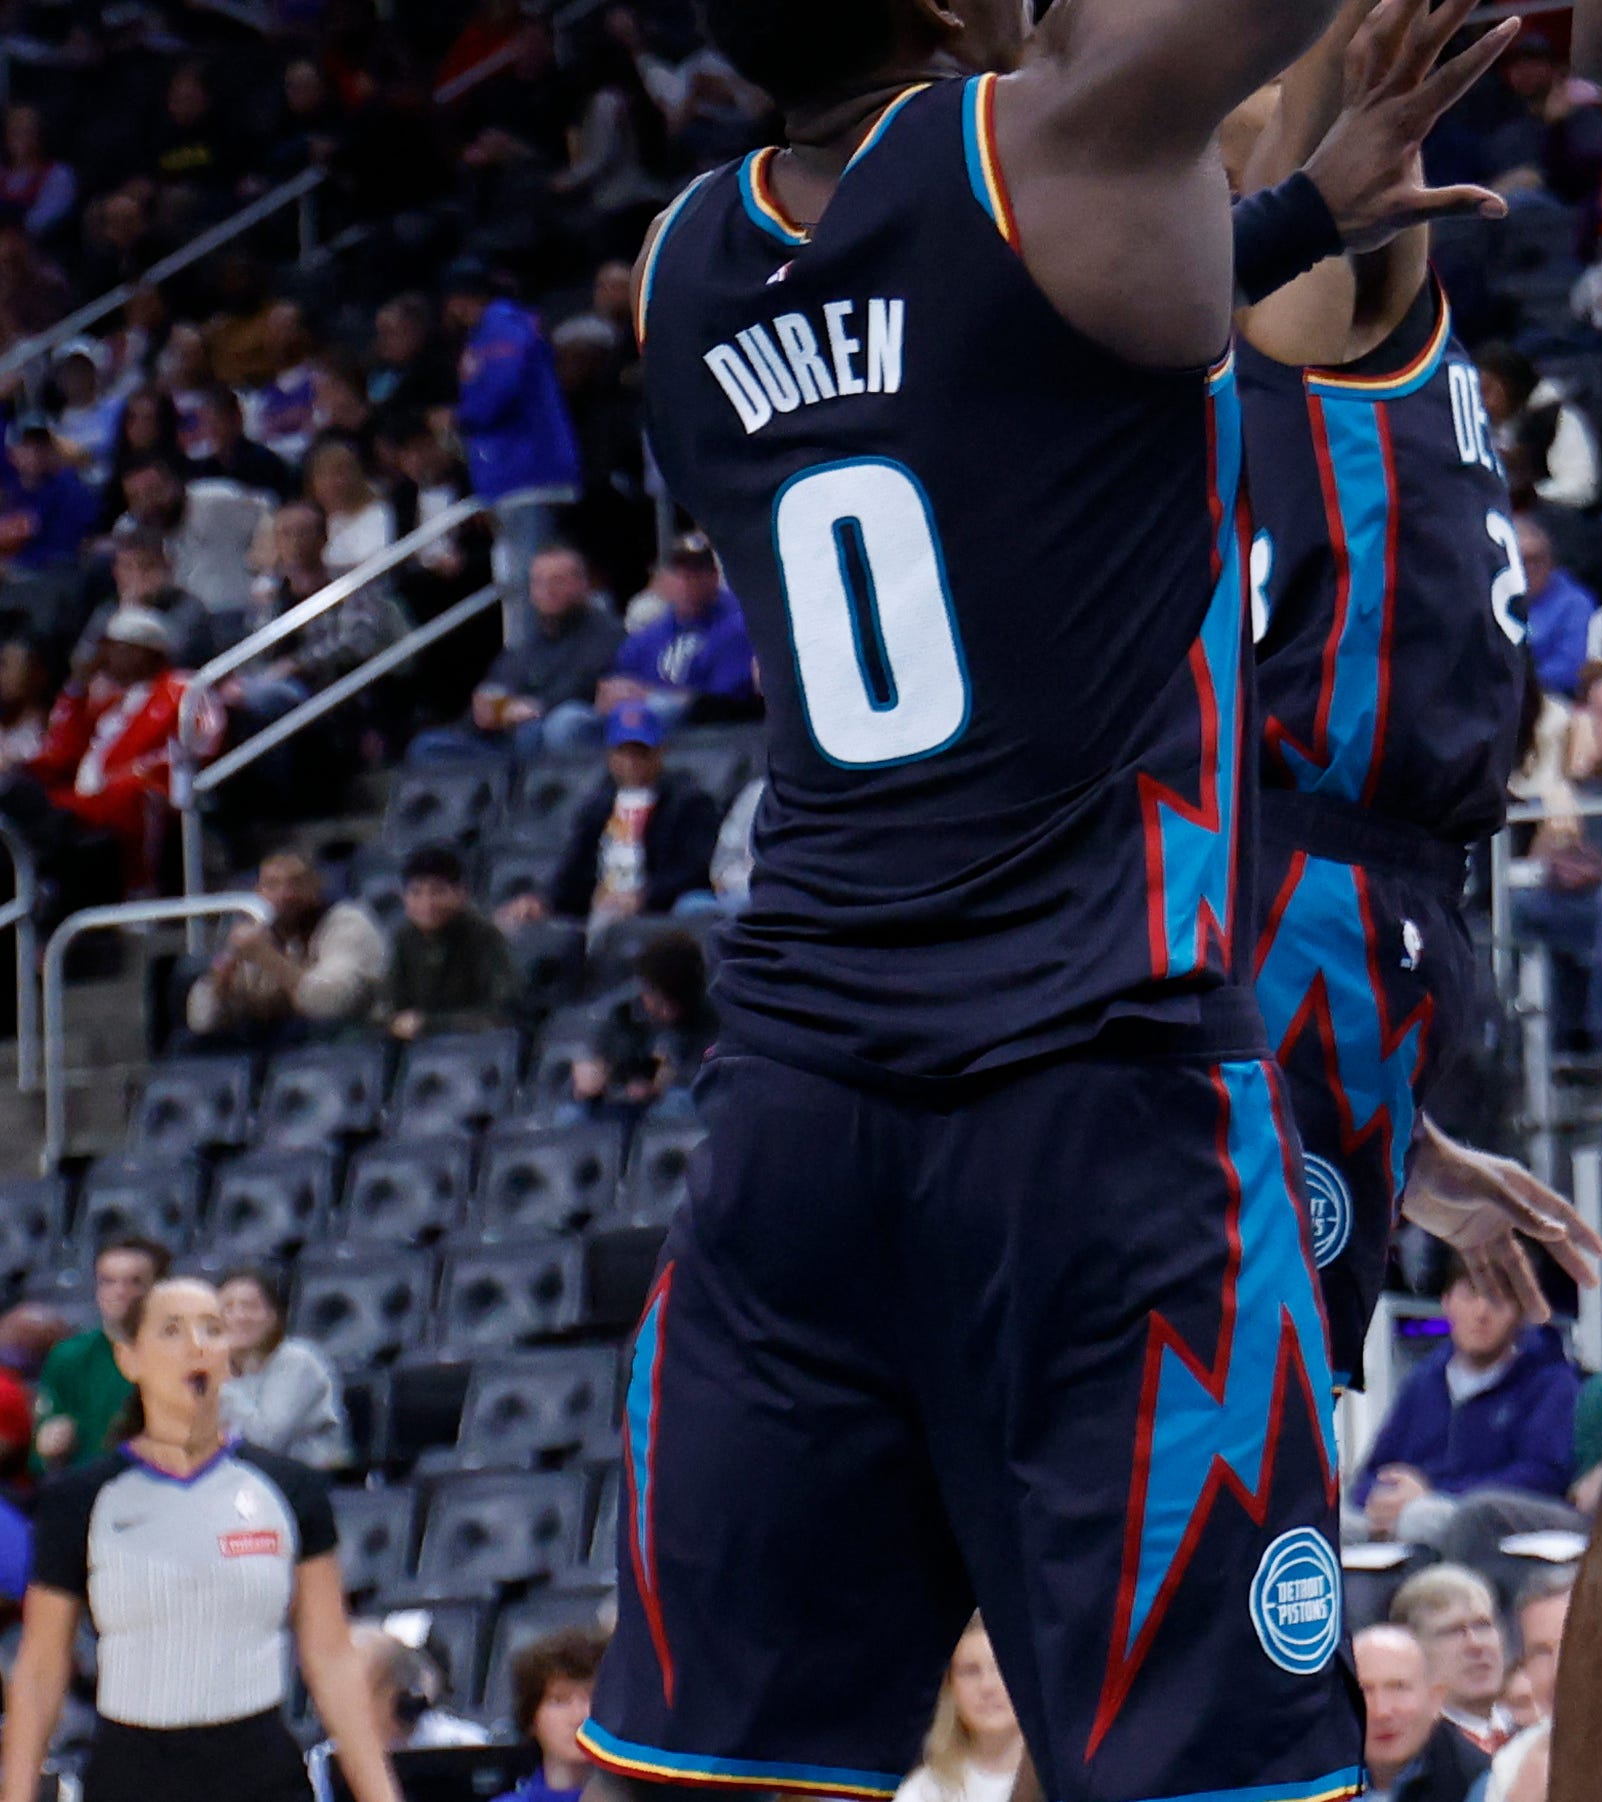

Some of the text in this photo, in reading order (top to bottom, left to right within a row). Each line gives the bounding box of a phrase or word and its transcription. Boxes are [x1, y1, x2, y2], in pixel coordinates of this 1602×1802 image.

[702, 297, 906, 435] DUREN
[771, 455, 973, 771] 0
[1276, 1575, 1326, 1603] DETROIT
[1276, 1599, 1328, 1626] PISTONS
